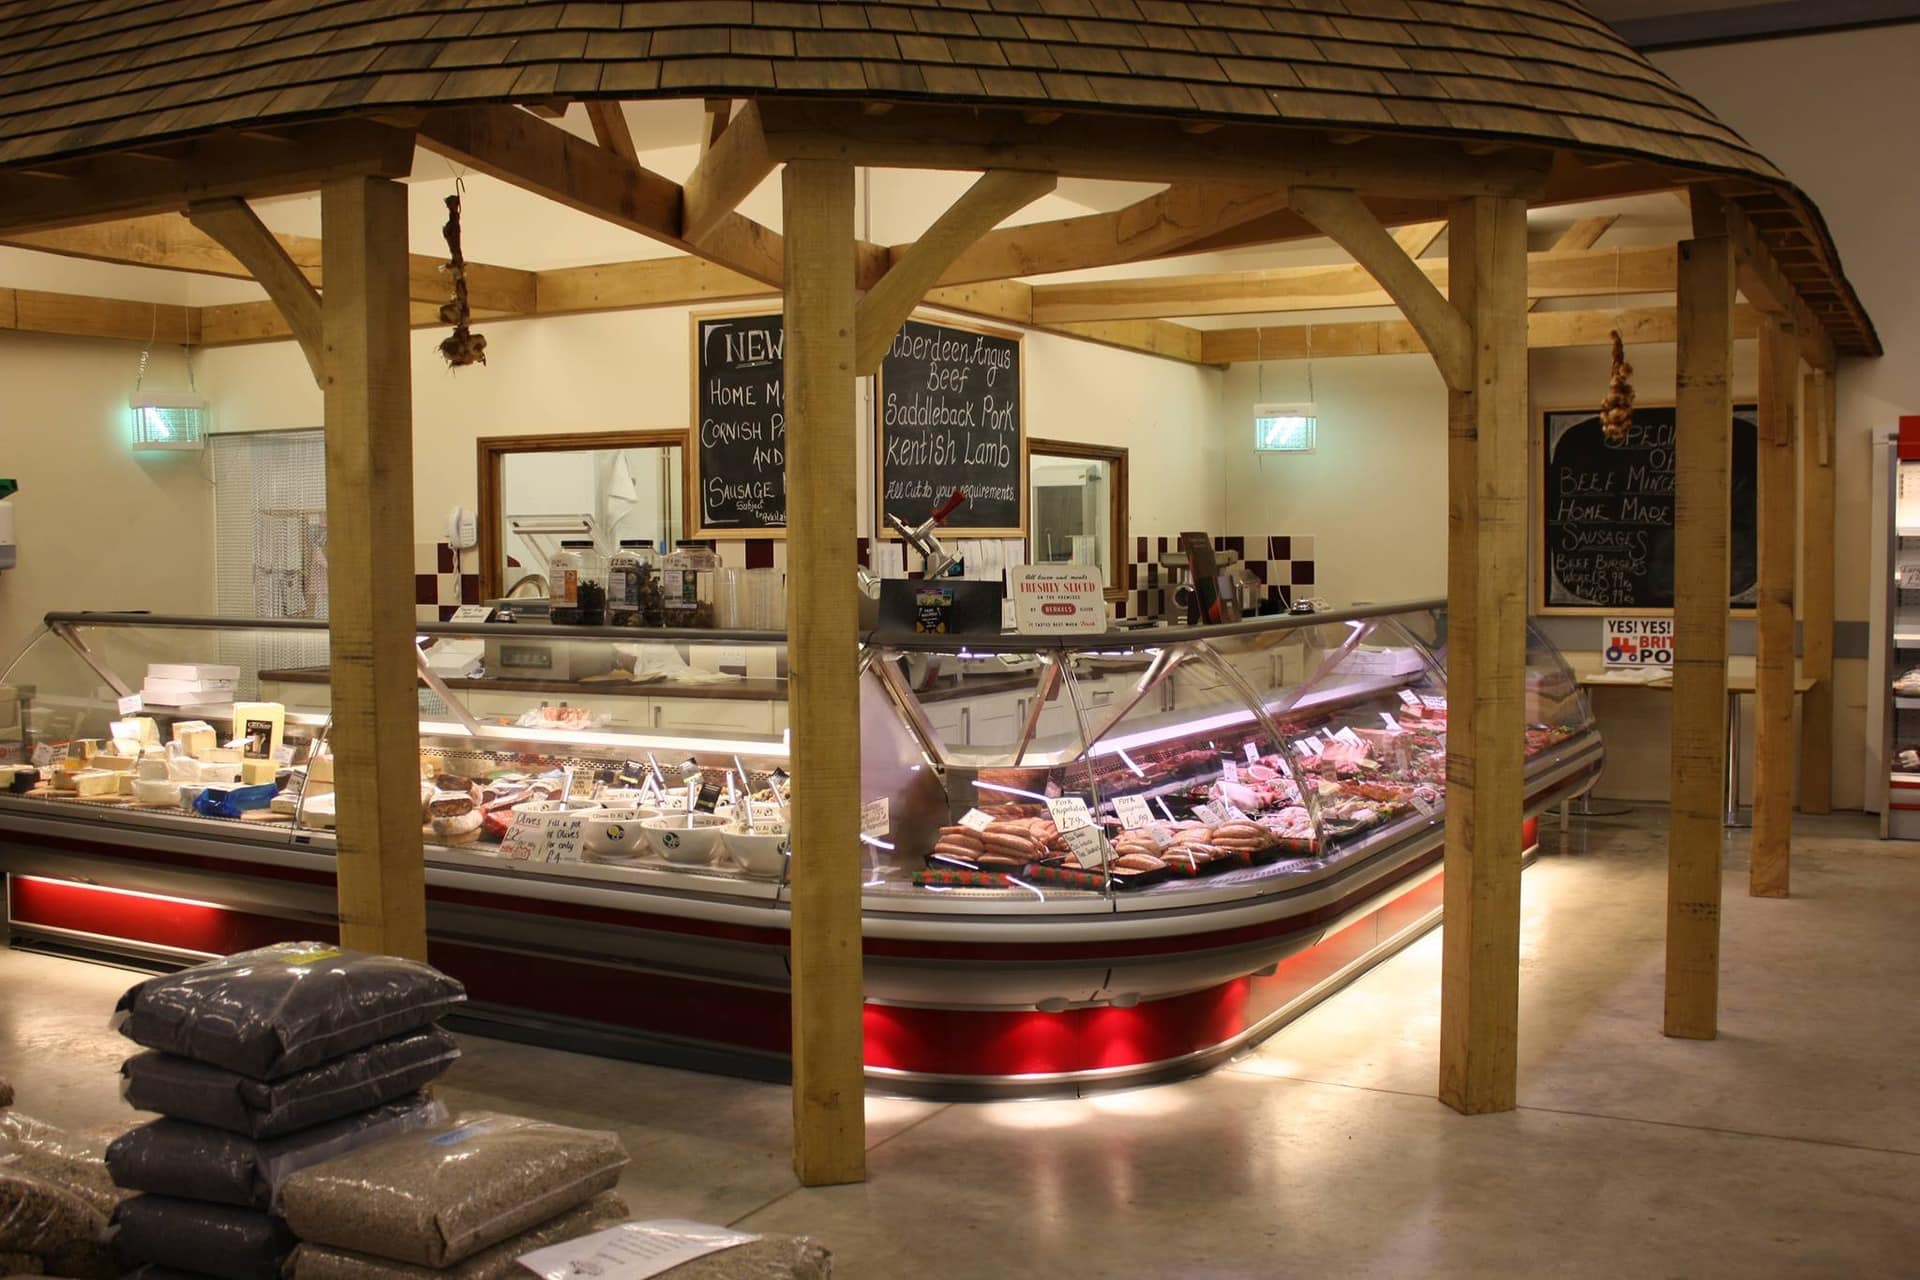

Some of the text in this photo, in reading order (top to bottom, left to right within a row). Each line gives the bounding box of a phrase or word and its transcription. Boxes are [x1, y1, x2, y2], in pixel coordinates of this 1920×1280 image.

[725, 329, 784, 362] NEW
[970, 336, 1012, 387] Angus
[927, 361, 971, 394] Beef
[710, 378, 785, 408] HOME M
[885, 392, 1015, 432] Saddleback Pork
[701, 418, 762, 449] CORNISH
[753, 445, 784, 473] AND
[885, 429, 1010, 468] Kentish Lamb
[709, 476, 775, 508] SAUSAGE
[885, 480, 904, 499] All
[933, 485, 957, 508] your
[1560, 466, 1616, 495] BEEF
[1558, 498, 1610, 521] HOME
[1020, 582, 1096, 593] FRESHLY SLICED
[1608, 620, 1671, 634] YES! YES!
[556, 829, 580, 839] Olives
[570, 820, 582, 829] pot
[558, 840, 574, 853] only
